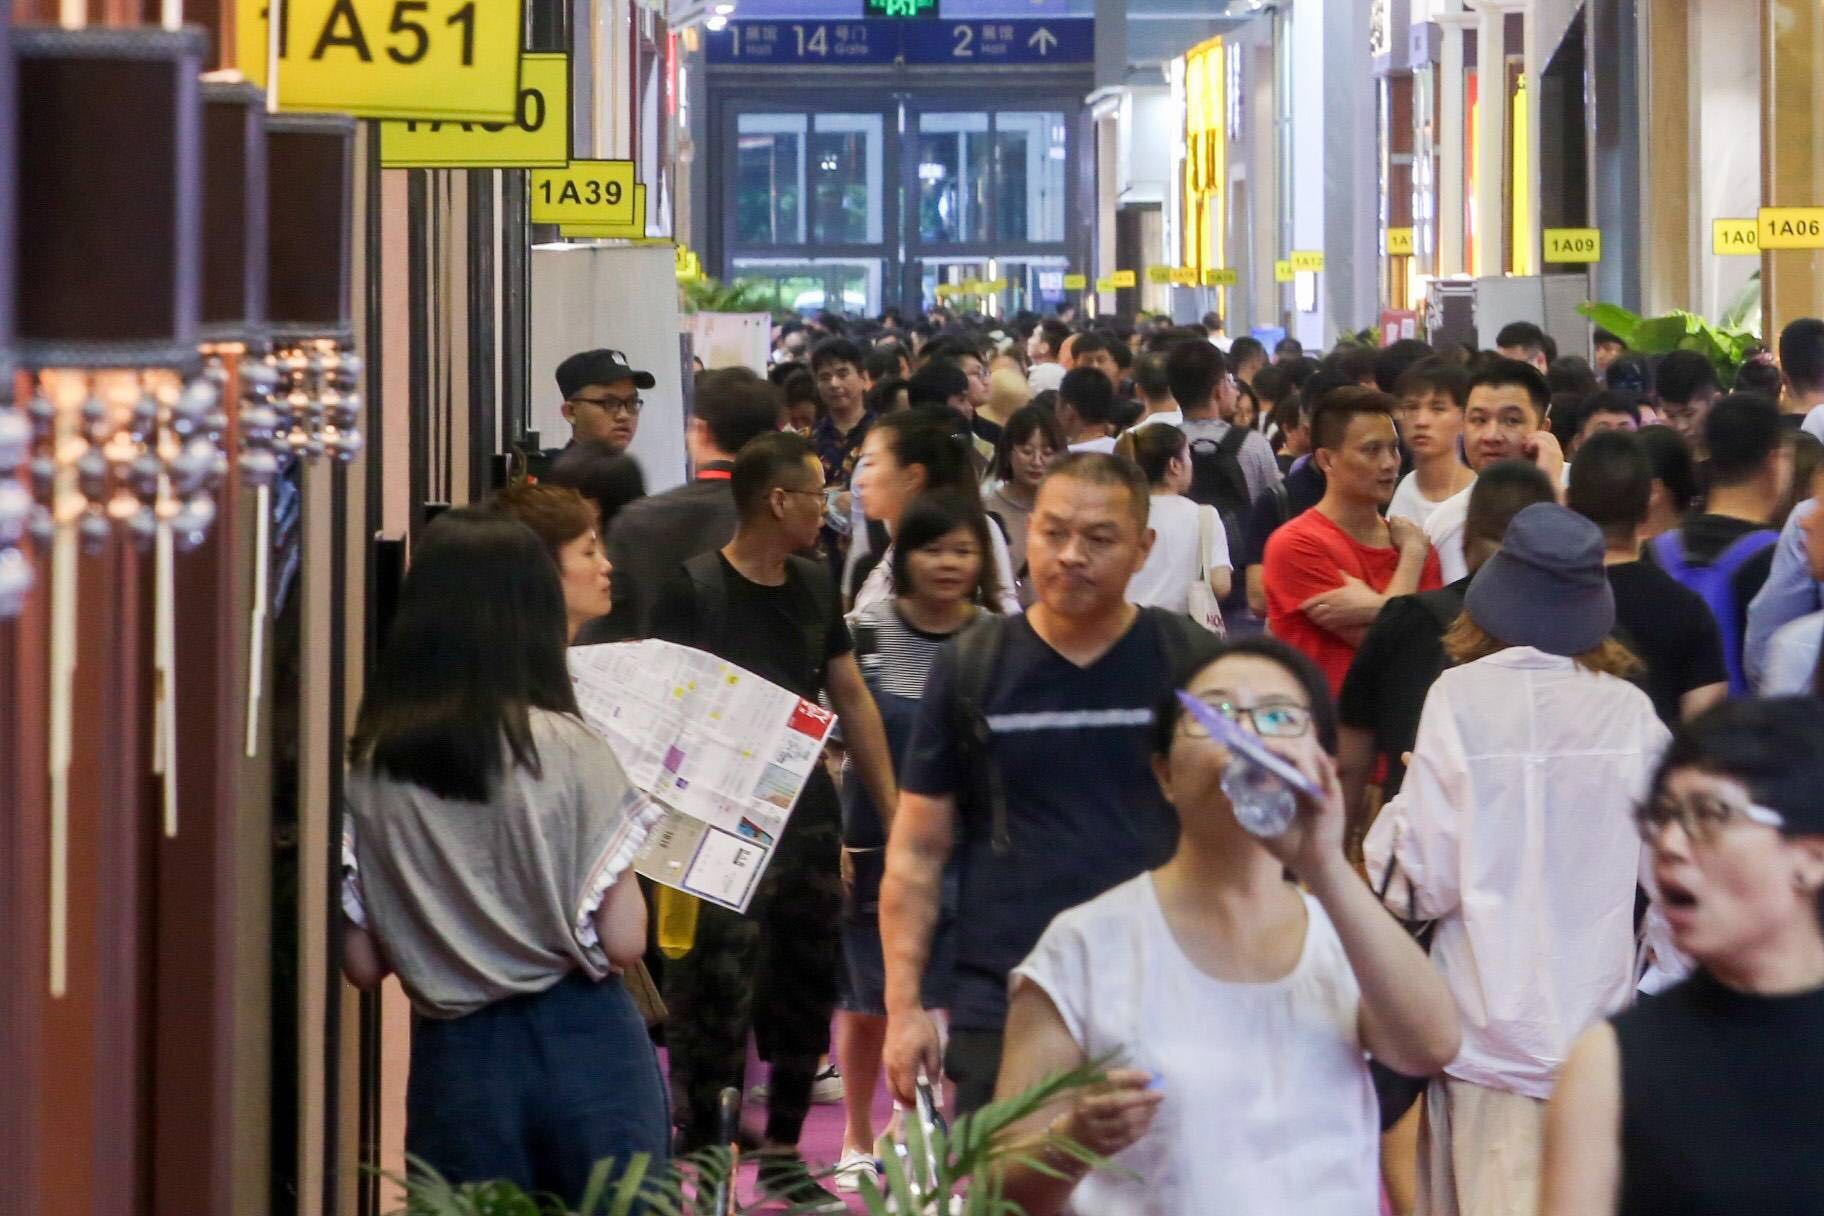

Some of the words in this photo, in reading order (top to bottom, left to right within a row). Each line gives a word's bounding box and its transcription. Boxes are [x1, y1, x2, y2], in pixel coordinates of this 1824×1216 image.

[728, 25, 740, 57] 1
[792, 25, 828, 57] 14
[953, 24, 973, 57] 2
[538, 179, 623, 207] 1A39
[1767, 219, 1821, 237] 1A06
[1552, 238, 1595, 253] 1A09
[1722, 230, 1757, 246] 1A0
